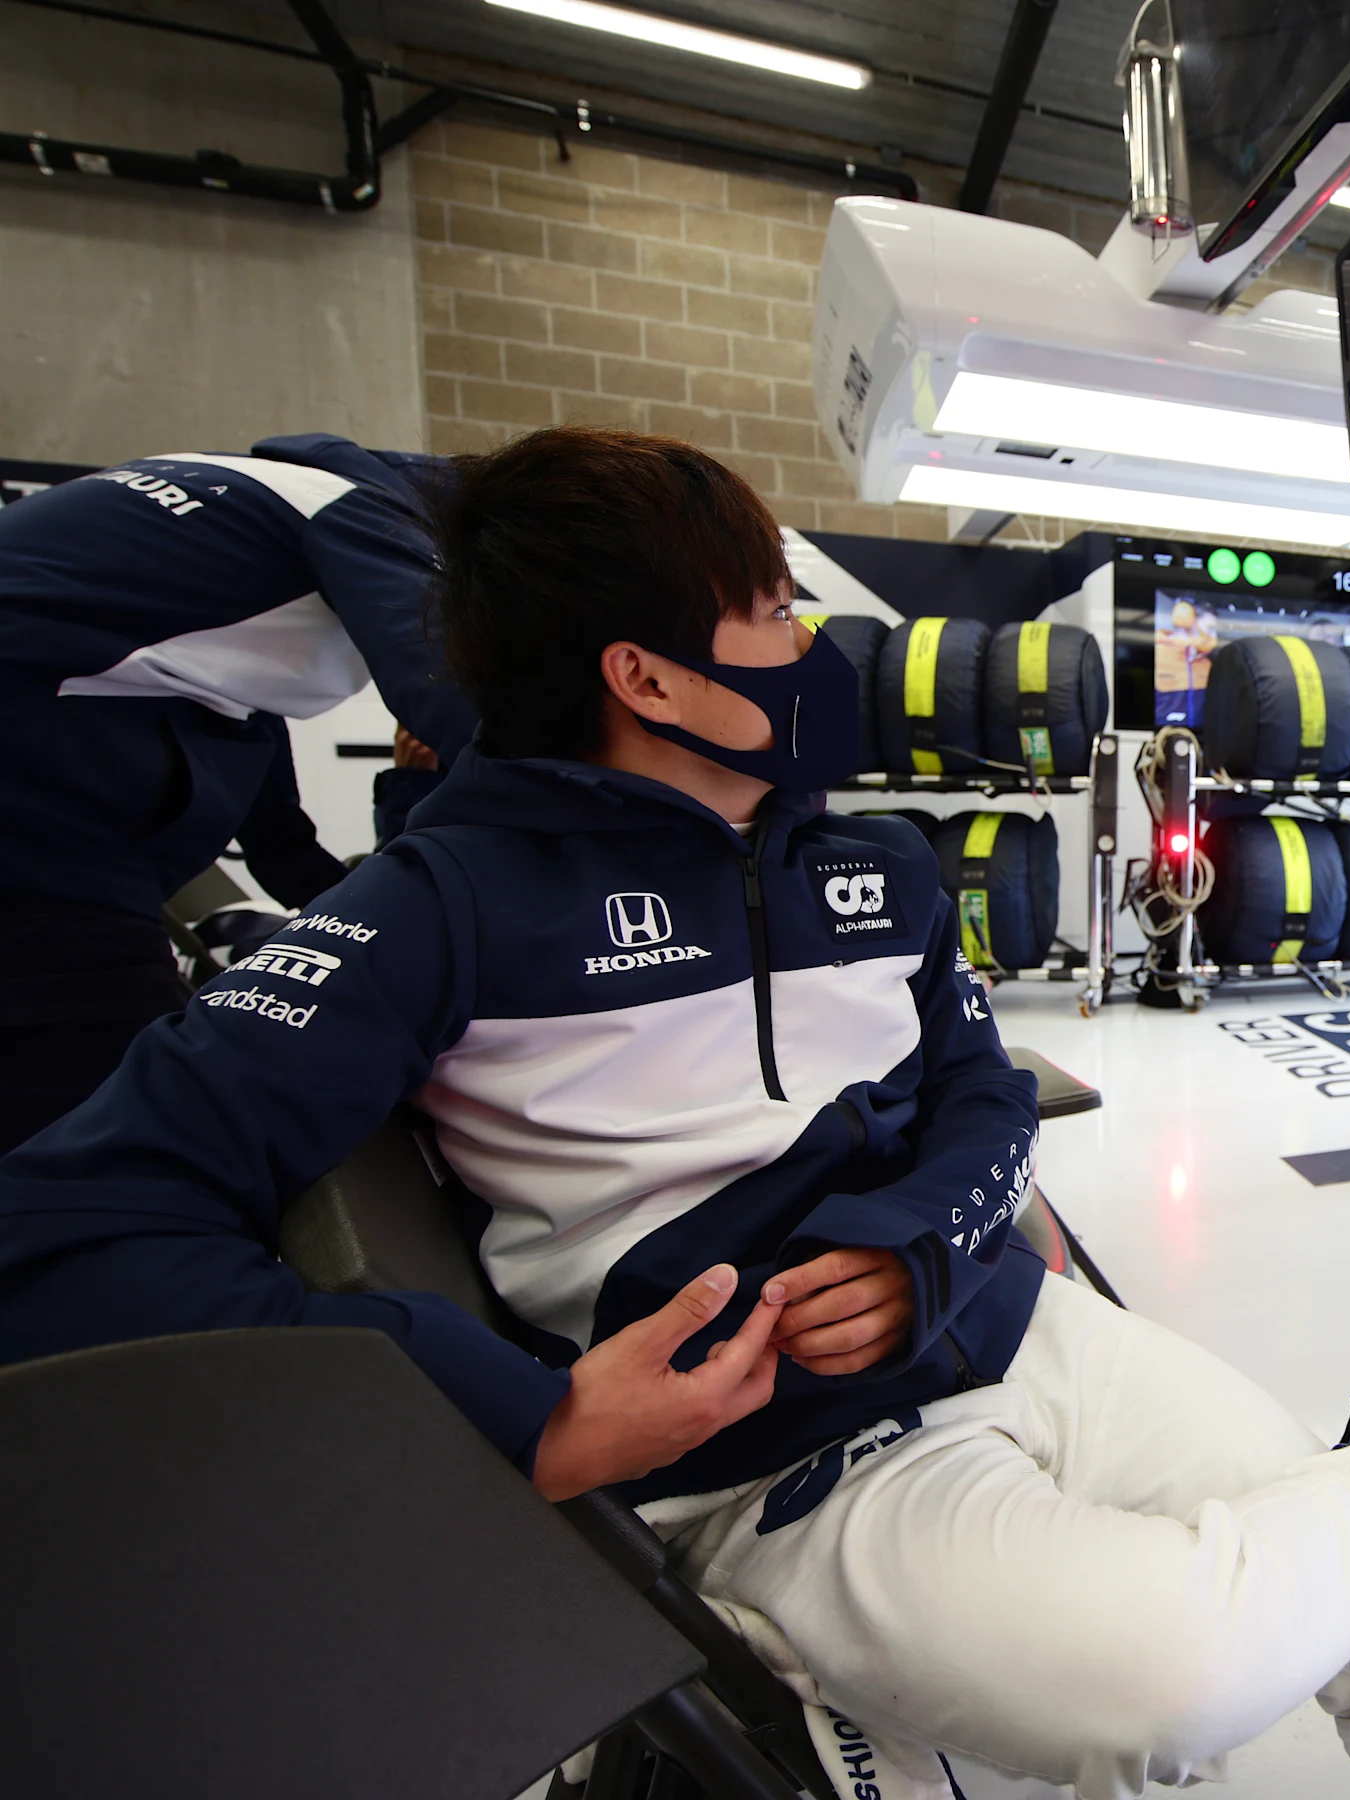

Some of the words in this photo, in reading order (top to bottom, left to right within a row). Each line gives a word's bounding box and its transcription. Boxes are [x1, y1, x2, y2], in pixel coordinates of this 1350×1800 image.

[817, 862, 875, 872] SCUDERIA
[836, 918, 893, 934] ALPHATAURI
[584, 944, 712, 976] HONDA
[827, 1709, 882, 1800] SHIO
